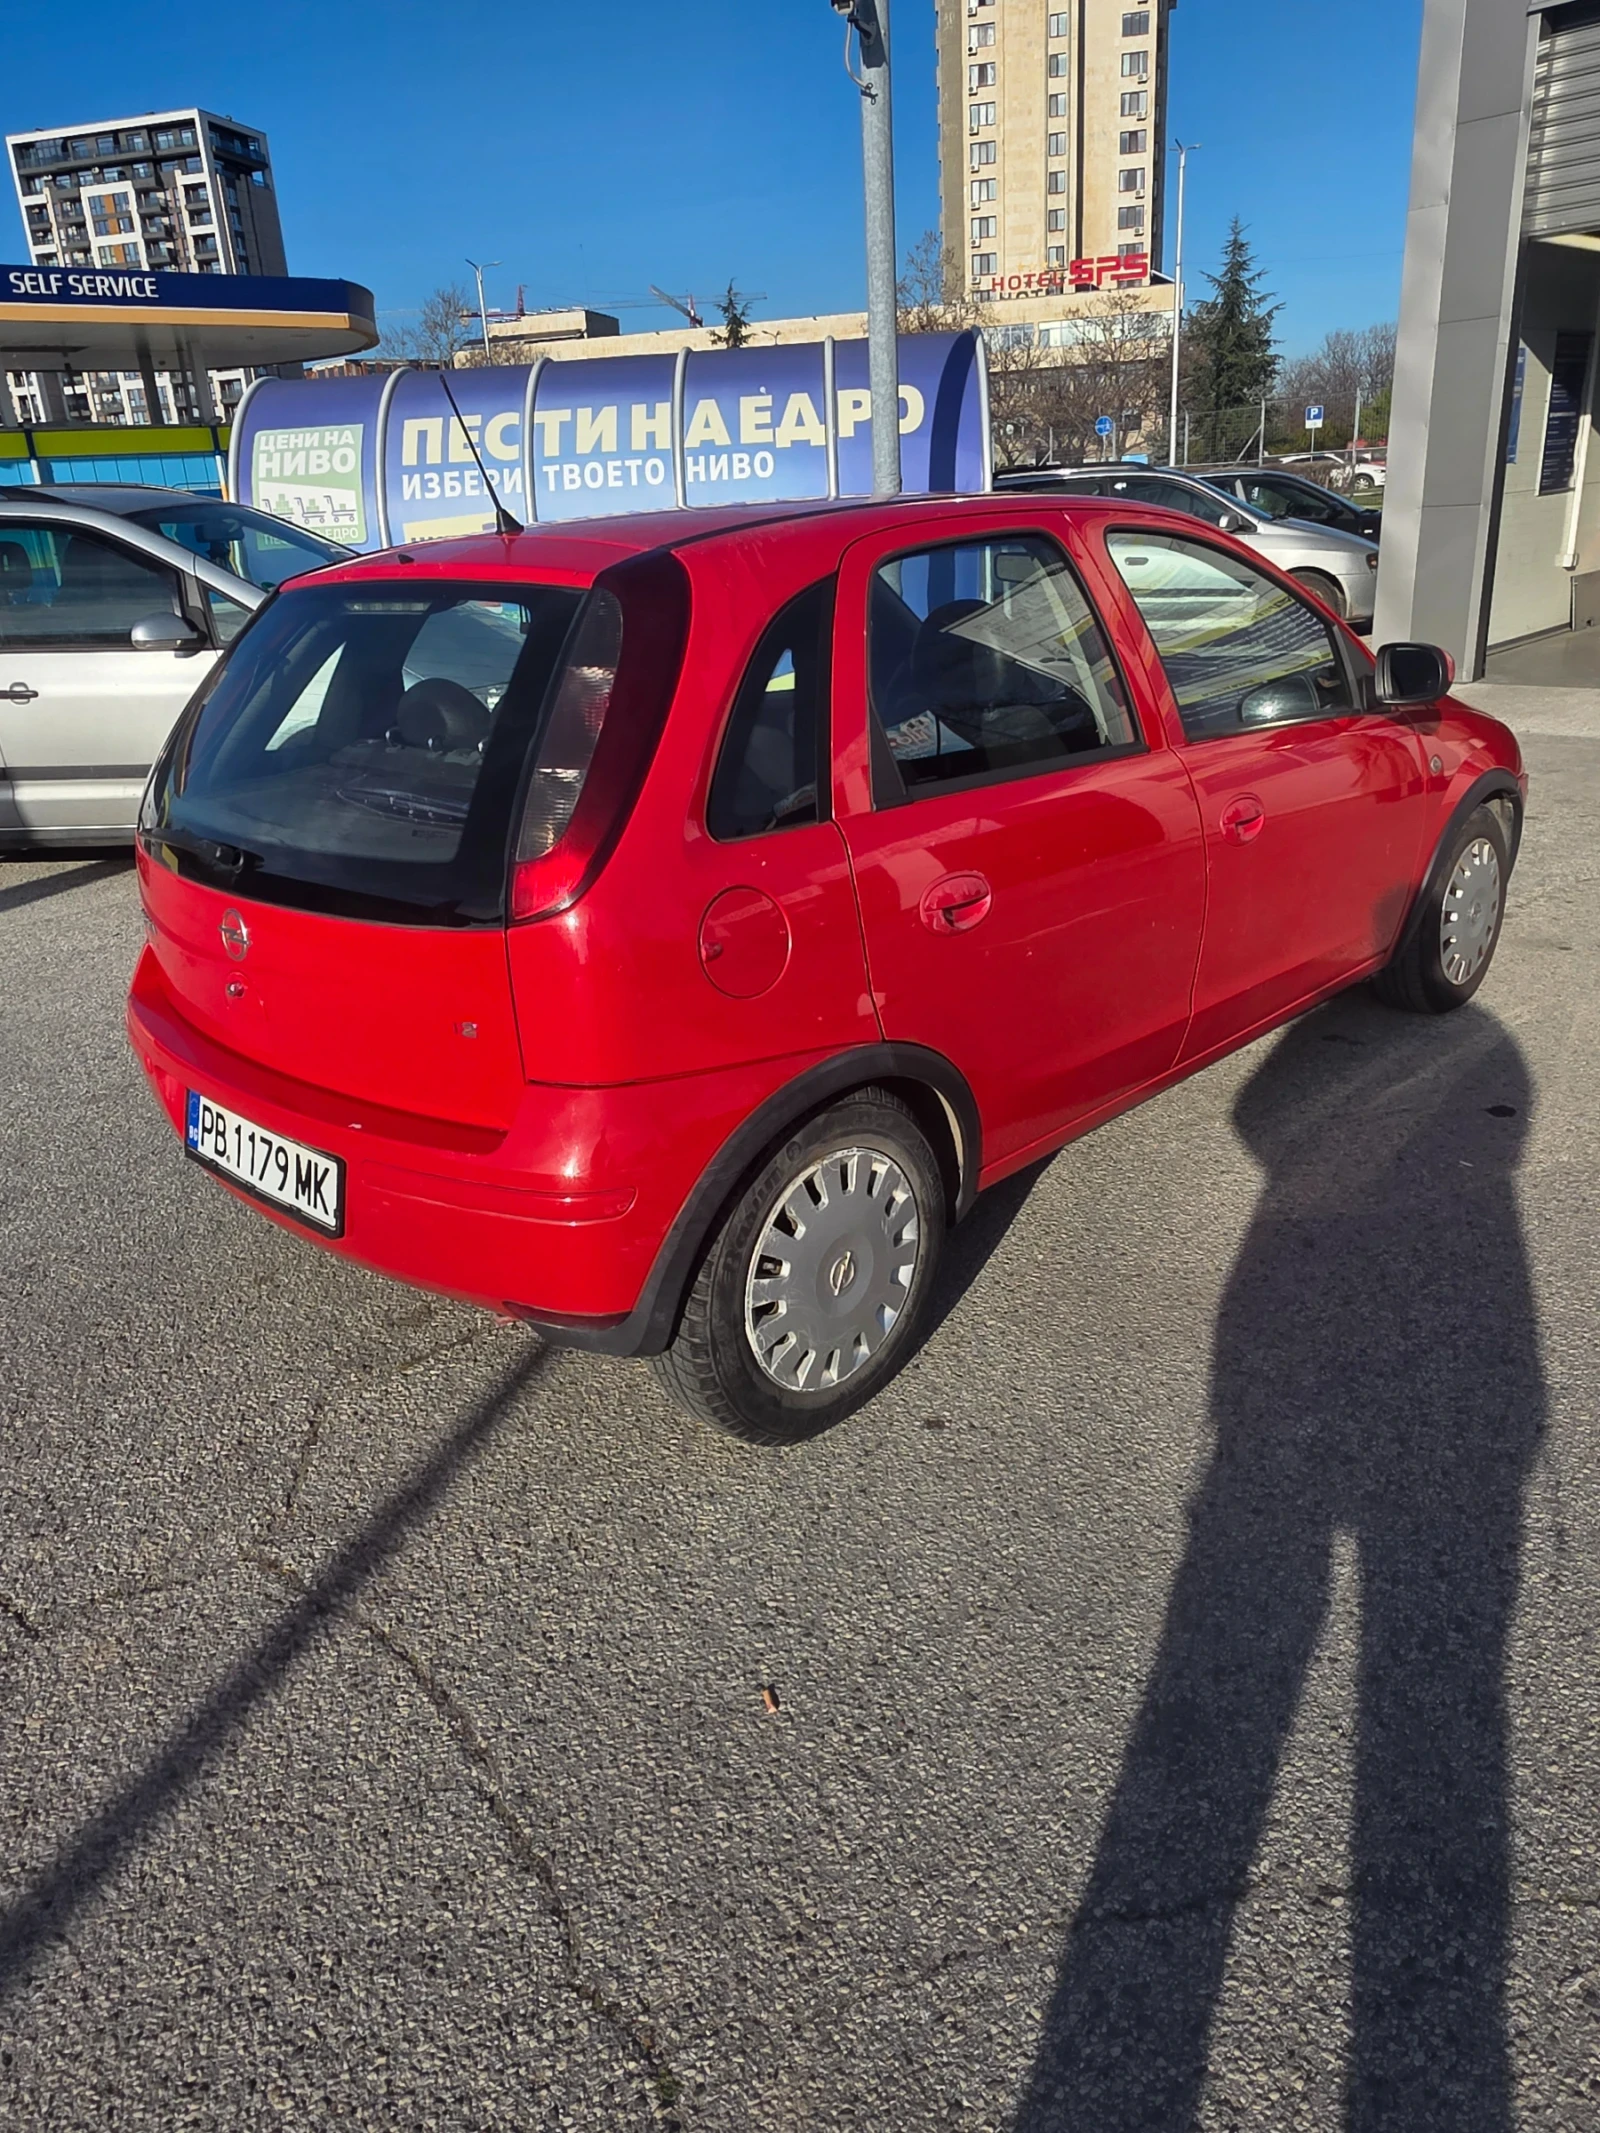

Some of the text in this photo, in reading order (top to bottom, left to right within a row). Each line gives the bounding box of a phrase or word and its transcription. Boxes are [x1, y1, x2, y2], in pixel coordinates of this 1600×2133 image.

[9, 272, 159, 298] SELF SERVICE
[991, 252, 1149, 293] HOTEL SPS
[259, 430, 355, 453] ЦЕНИ НА
[402, 405, 617, 466] ПЕСТИ
[258, 447, 357, 479] НИВО
[402, 450, 775, 501] ИЗБЕРИ ТВОЕТО НИВО
[188, 1125, 198, 1141] BG
